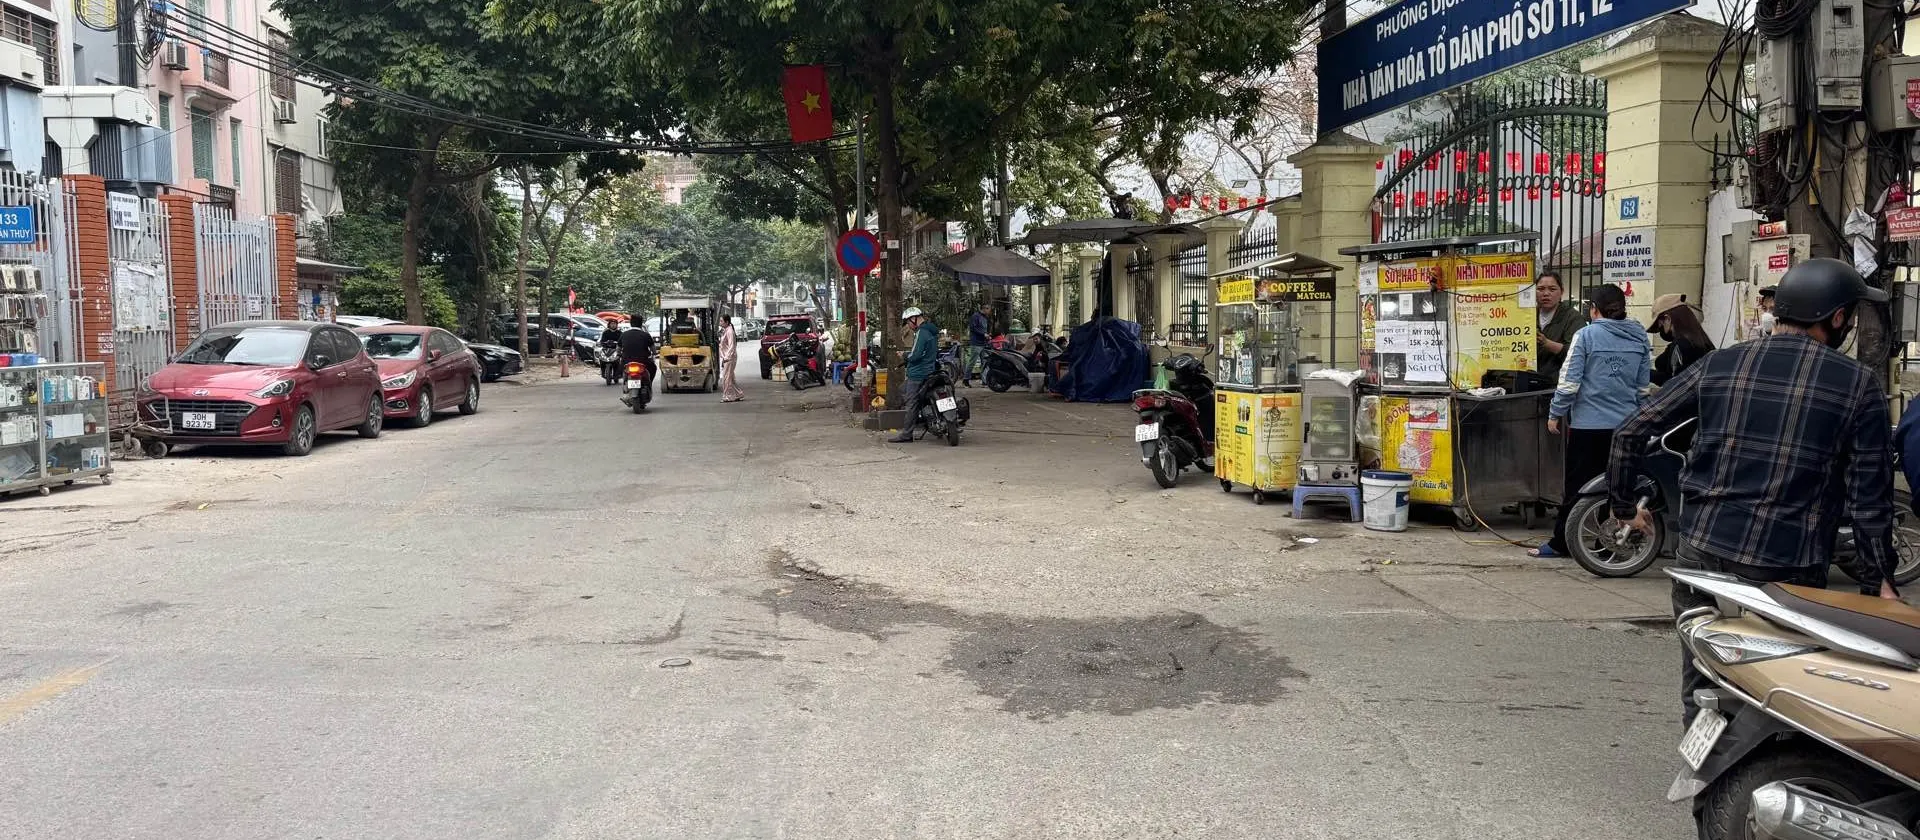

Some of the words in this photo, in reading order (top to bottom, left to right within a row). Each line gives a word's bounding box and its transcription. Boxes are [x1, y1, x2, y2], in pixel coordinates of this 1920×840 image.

[1377, 2, 1427, 41] PHƯỜNG
[1343, 69, 1367, 110] NHÀ
[1370, 60, 1394, 99] VĂN
[1397, 47, 1425, 89] HÓA
[1428, 25, 1446, 78] TỔ
[1450, 24, 1484, 70] DÂN
[1623, 201, 1635, 216] 63
[11, 227, 30, 238] THỦY
[1615, 231, 1642, 246] CẤM
[1606, 248, 1624, 258] BÁN
[1627, 246, 1651, 257] HÀNG
[1642, 259, 1652, 267] XE
[1270, 282, 1315, 293] COFFEE
[1297, 292, 1331, 300] MATCHA
[1456, 293, 1498, 304] COMBO
[1489, 307, 1507, 319] 30k
[1480, 327, 1521, 337] COMBO
[1524, 326, 1531, 335] 2
[1383, 336, 1394, 345] 5K
[1511, 341, 1529, 352] 25k
[1804, 667, 1891, 690] LEAD
